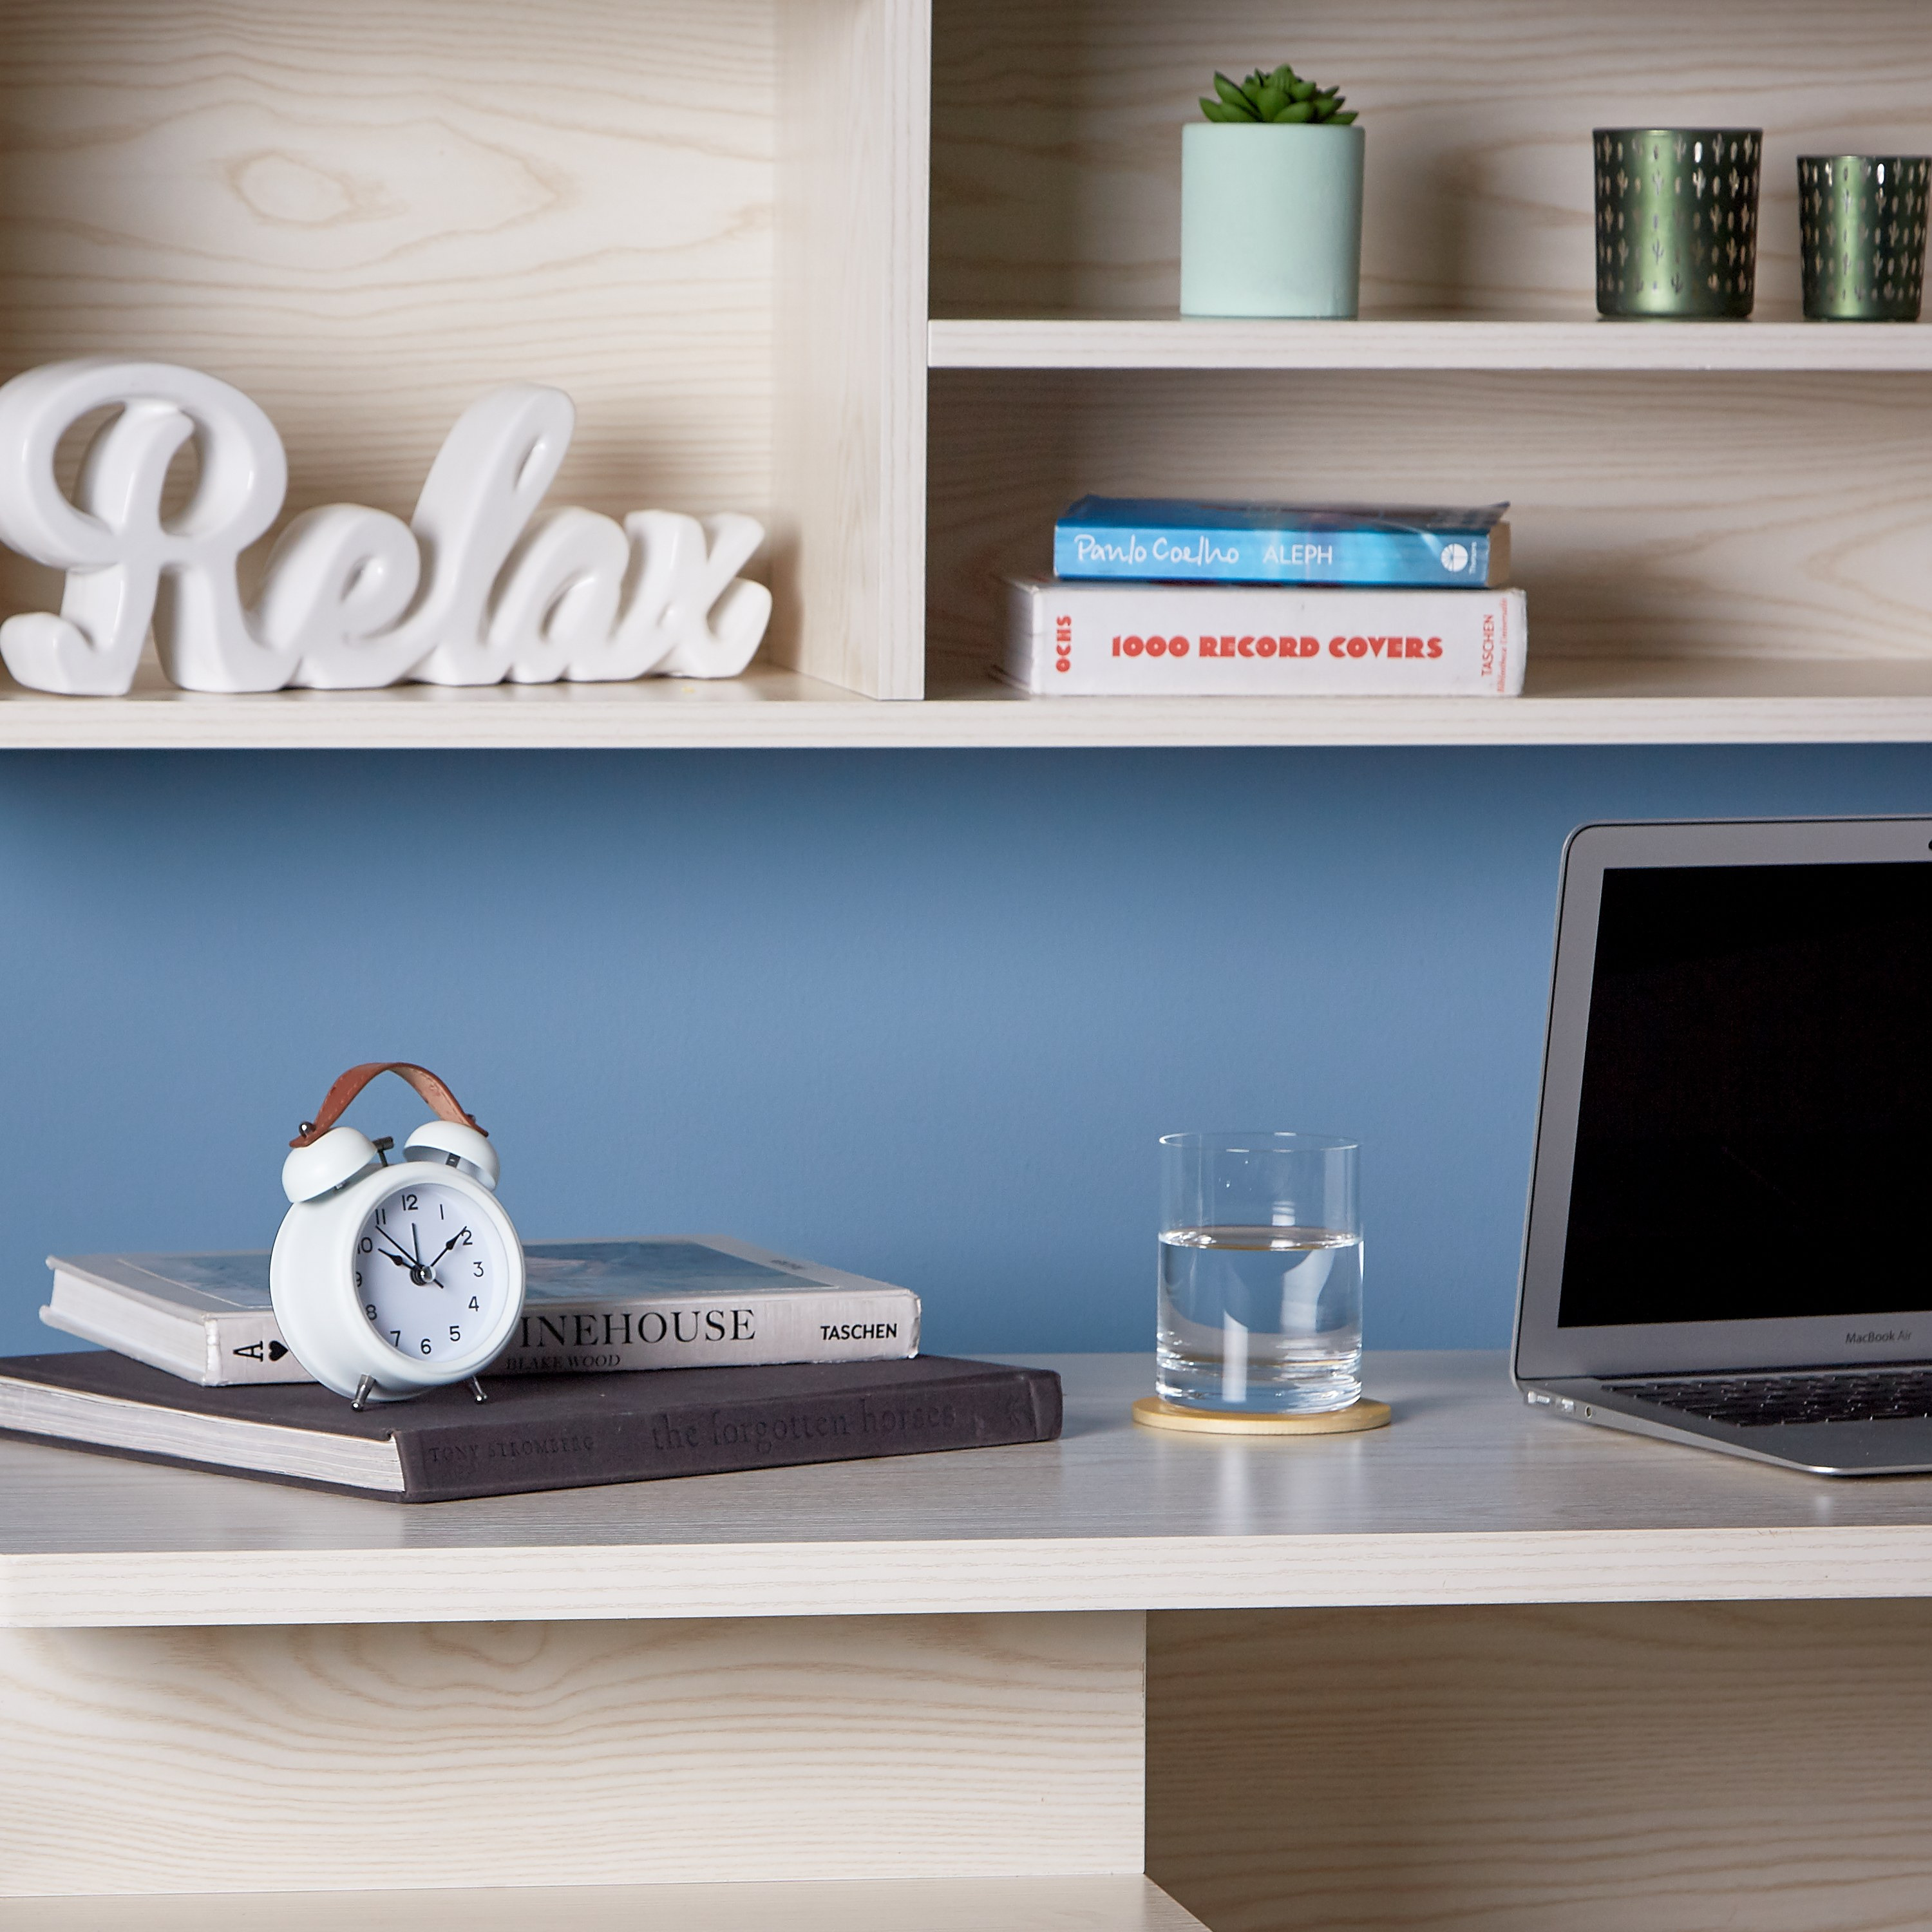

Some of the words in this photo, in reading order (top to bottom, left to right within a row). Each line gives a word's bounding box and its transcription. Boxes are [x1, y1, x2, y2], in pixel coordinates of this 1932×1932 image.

[0, 359, 773, 696] Relax
[1074, 534, 1147, 565] Paulo
[1153, 536, 1239, 567] Coelho
[1262, 544, 1333, 565] ALEPH
[1056, 615, 1072, 673] OCHS
[1112, 635, 1190, 657] 1000
[1198, 635, 1320, 658] RECORD
[1329, 636, 1443, 659] COVERS
[1482, 614, 1495, 677] TASCHEN
[402, 1194, 418, 1211] 12
[375, 1208, 386, 1225] 11
[439, 1204, 444, 1220] 1
[461, 1229, 473, 1246] 2
[473, 1261, 484, 1278] 3
[365, 1303, 377, 1321] 8
[468, 1295, 480, 1312] 4
[449, 1325, 461, 1342] 5
[520, 1308, 755, 1348] INEHOUSE
[820, 1323, 898, 1341] TASCHEN
[390, 1330, 401, 1347] 7
[1846, 1329, 1895, 1345] MacBook
[1897, 1329, 1912, 1340] Air
[420, 1338, 431, 1355] 6
[567, 1354, 621, 1368] WOOD
[652, 1412, 699, 1450] the
[710, 1408, 851, 1455] forgotten
